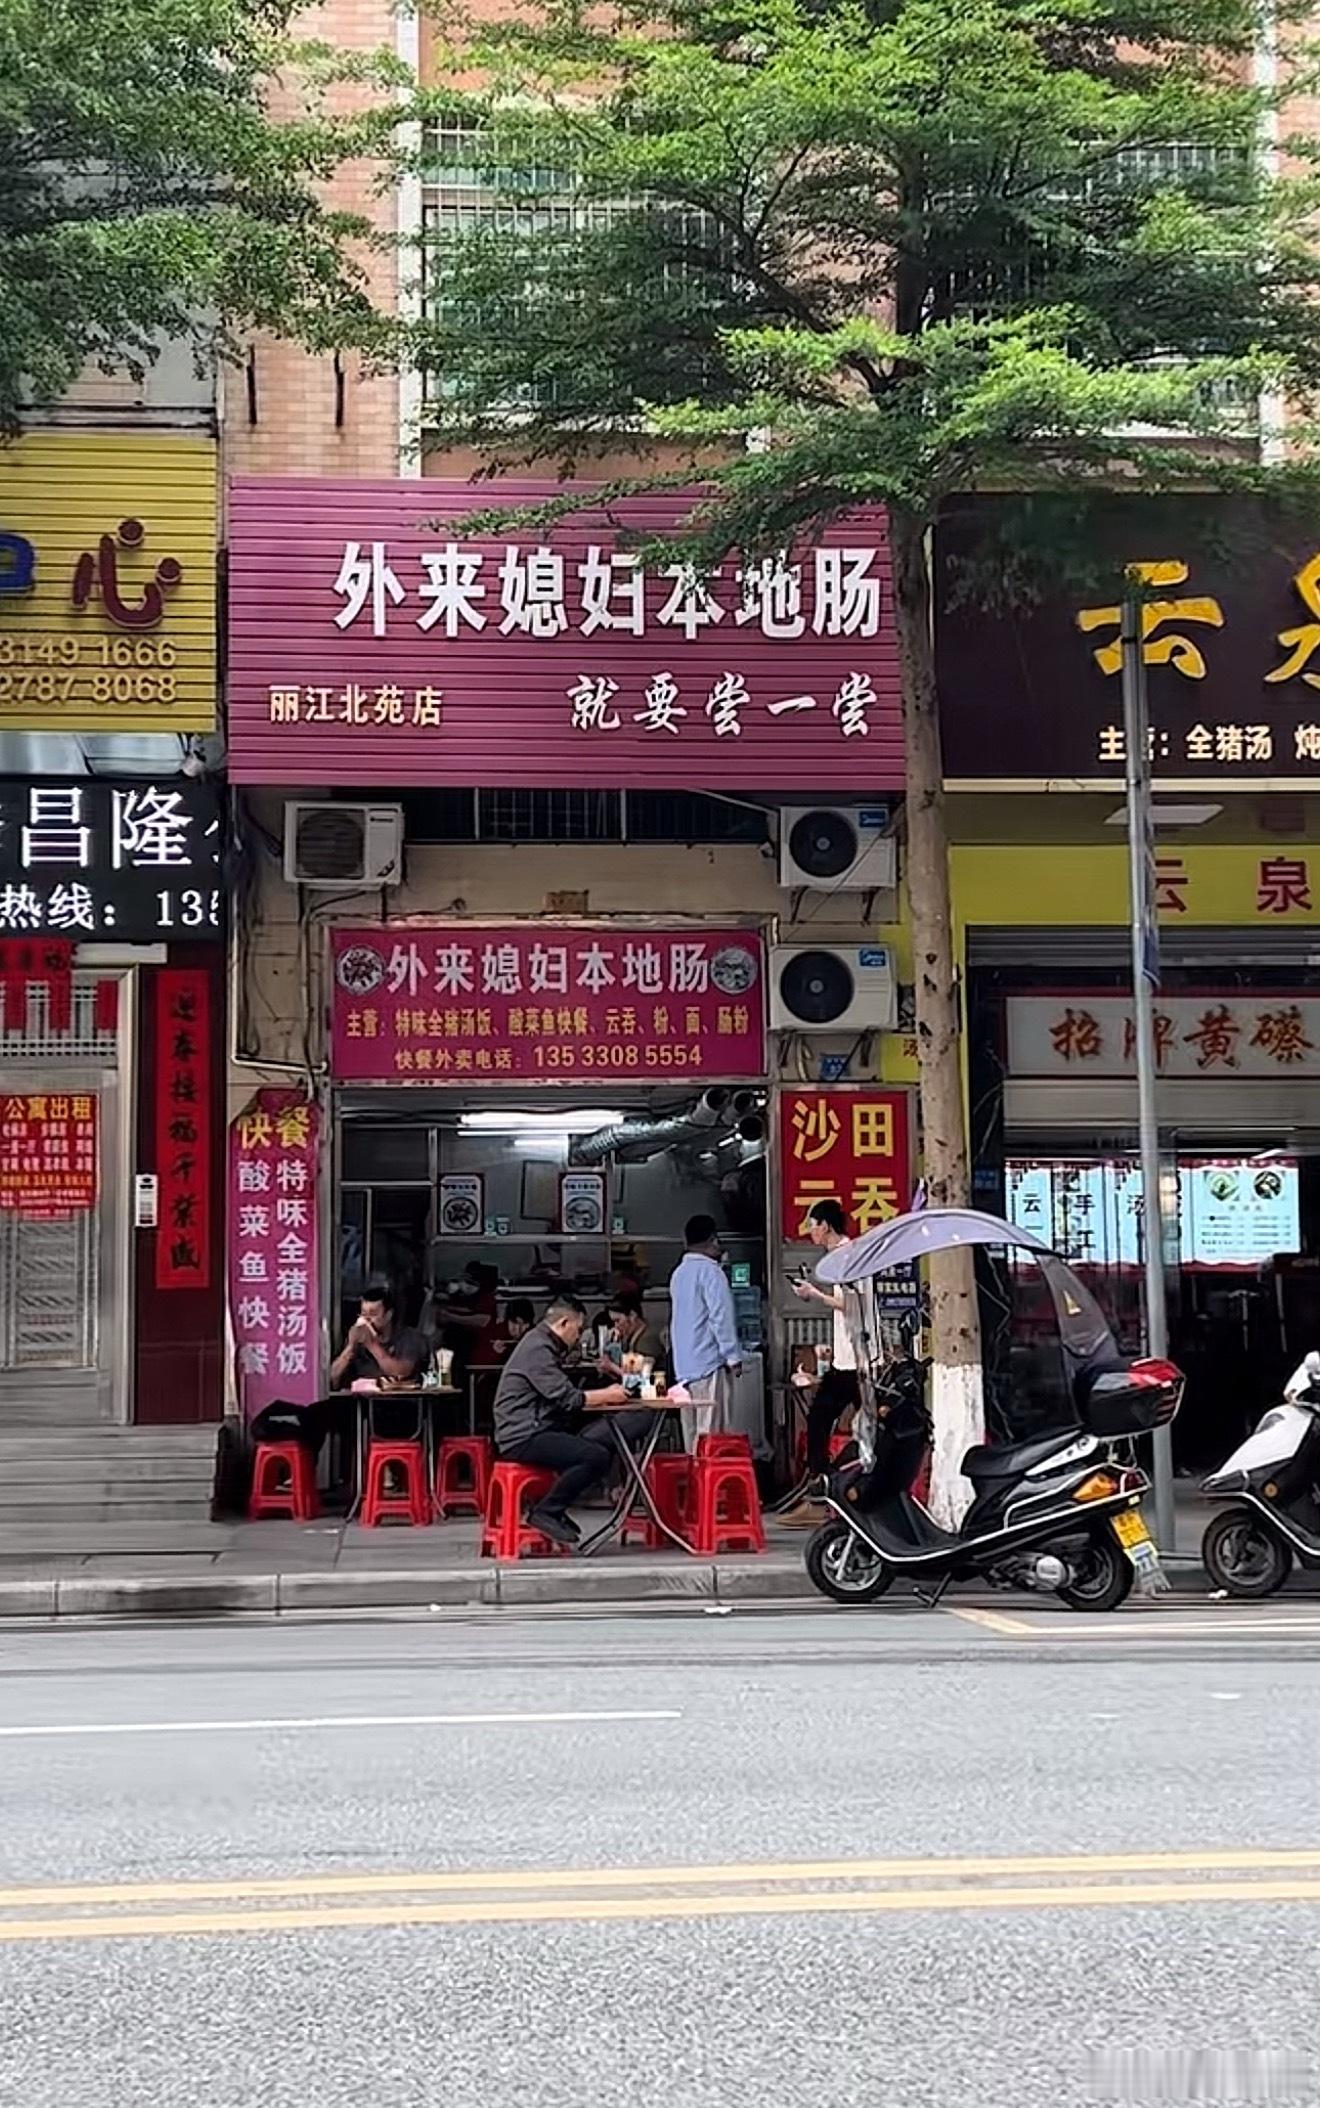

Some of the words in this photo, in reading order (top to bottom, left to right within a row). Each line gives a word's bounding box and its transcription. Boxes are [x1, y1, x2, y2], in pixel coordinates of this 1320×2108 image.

[333, 542, 880, 639] 外来媳妇本地肠
[0, 637, 79, 665] 3149
[100, 635, 176, 666] 1666
[0, 673, 77, 701] 2787
[92, 673, 176, 702] 8068
[269, 684, 444, 727] 丽江北苑店
[568, 671, 878, 738] 就要尝一尝
[1186, 724, 1272, 761] 全猪汤
[0, 786, 219, 869] 昌隆
[387, 943, 709, 996] 外来媳妇本地肠
[534, 1046, 575, 1068] 135
[582, 1045, 640, 1068] 3308
[644, 1045, 703, 1068] 5554
[237, 1106, 310, 1149] 快餐
[791, 1099, 894, 1161] 沙田
[237, 1160, 270, 1375] 酸菜鱼快餐
[276, 1158, 308, 1374] 特味全猪汤饭
